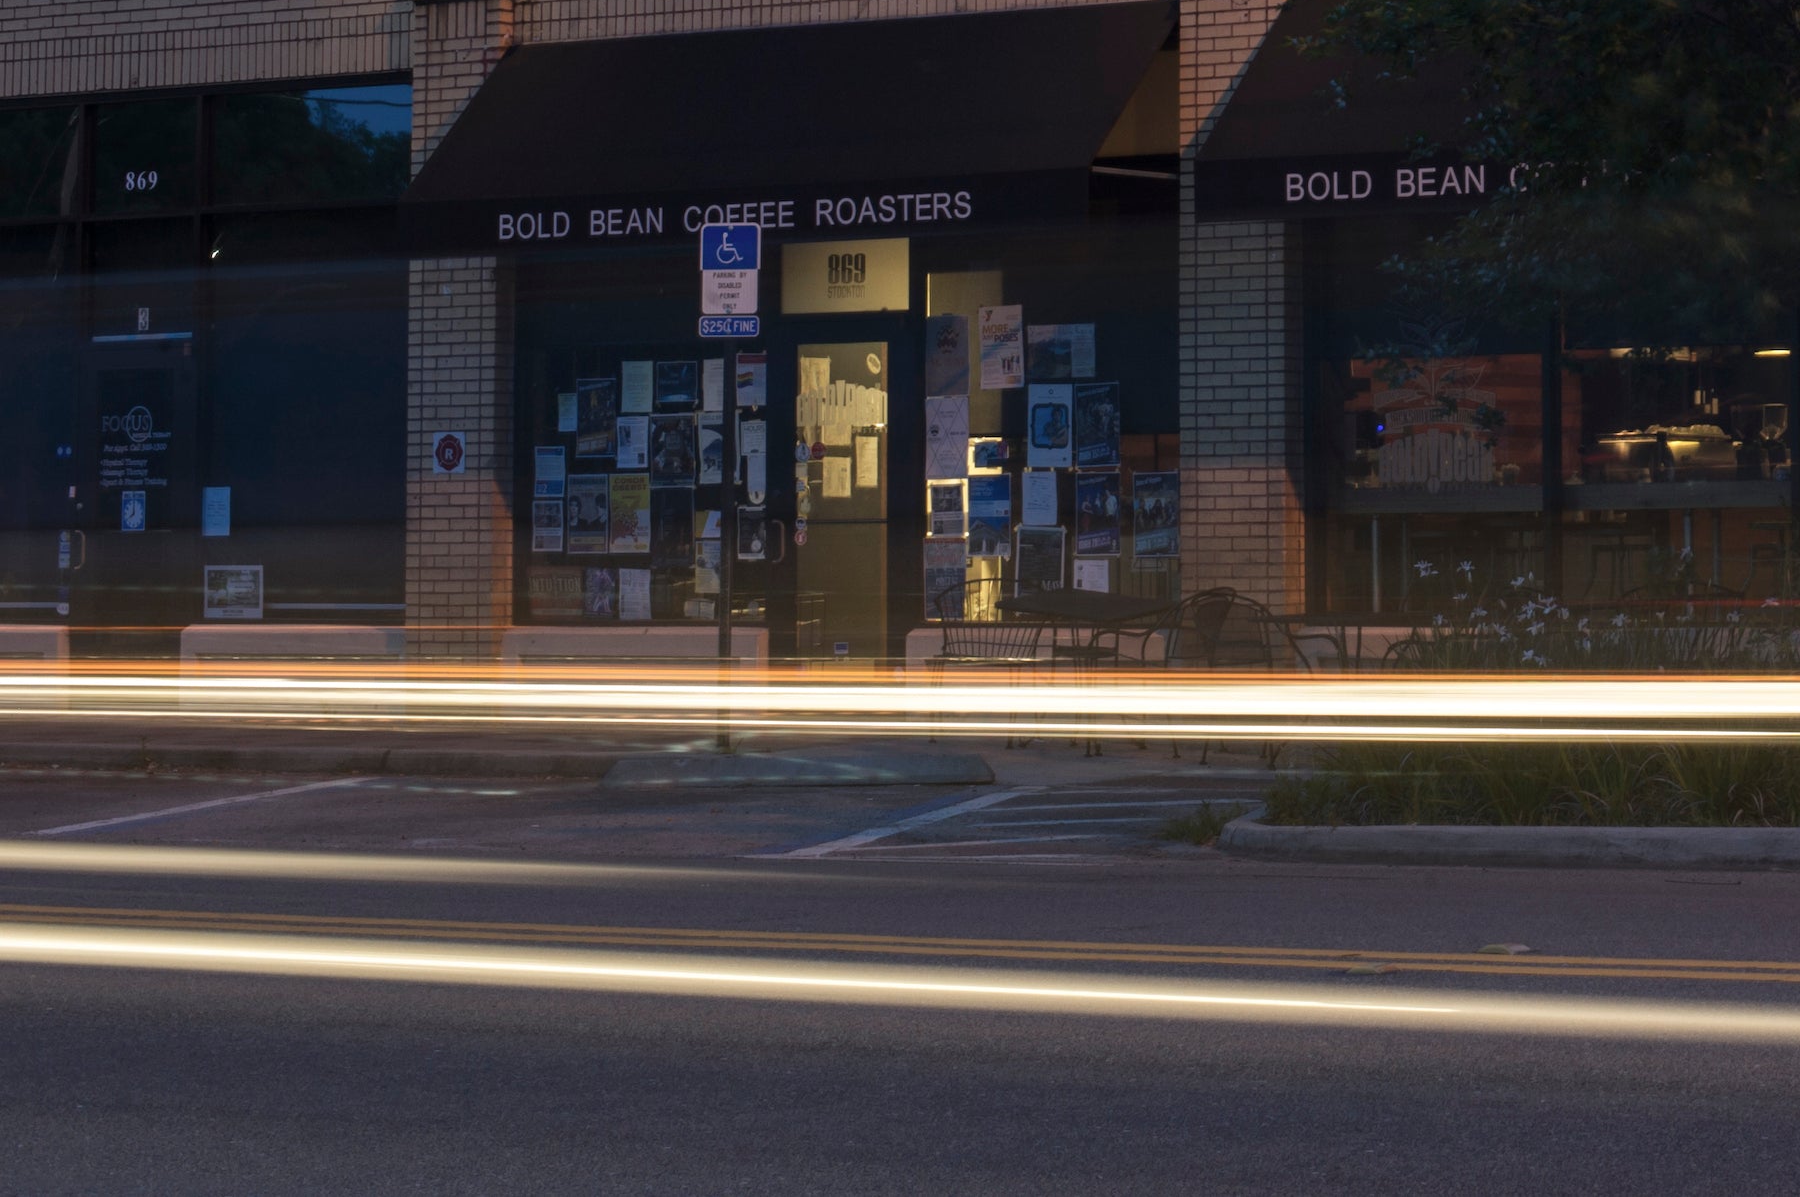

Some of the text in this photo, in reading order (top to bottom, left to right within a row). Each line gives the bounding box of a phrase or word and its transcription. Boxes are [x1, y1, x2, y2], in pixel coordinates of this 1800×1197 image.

[125, 170, 159, 191] 869
[1286, 170, 1372, 202] BOLD
[1397, 164, 1485, 198] BEAN
[499, 191, 972, 240] BOLD BEAN COFFEE ROASTERS
[828, 253, 866, 284] 869
[702, 319, 756, 334] $250 FINE
[982, 324, 1009, 334] MORE
[994, 333, 1018, 343] POSES
[102, 414, 149, 432] FOCUS
[445, 448, 454, 460] R
